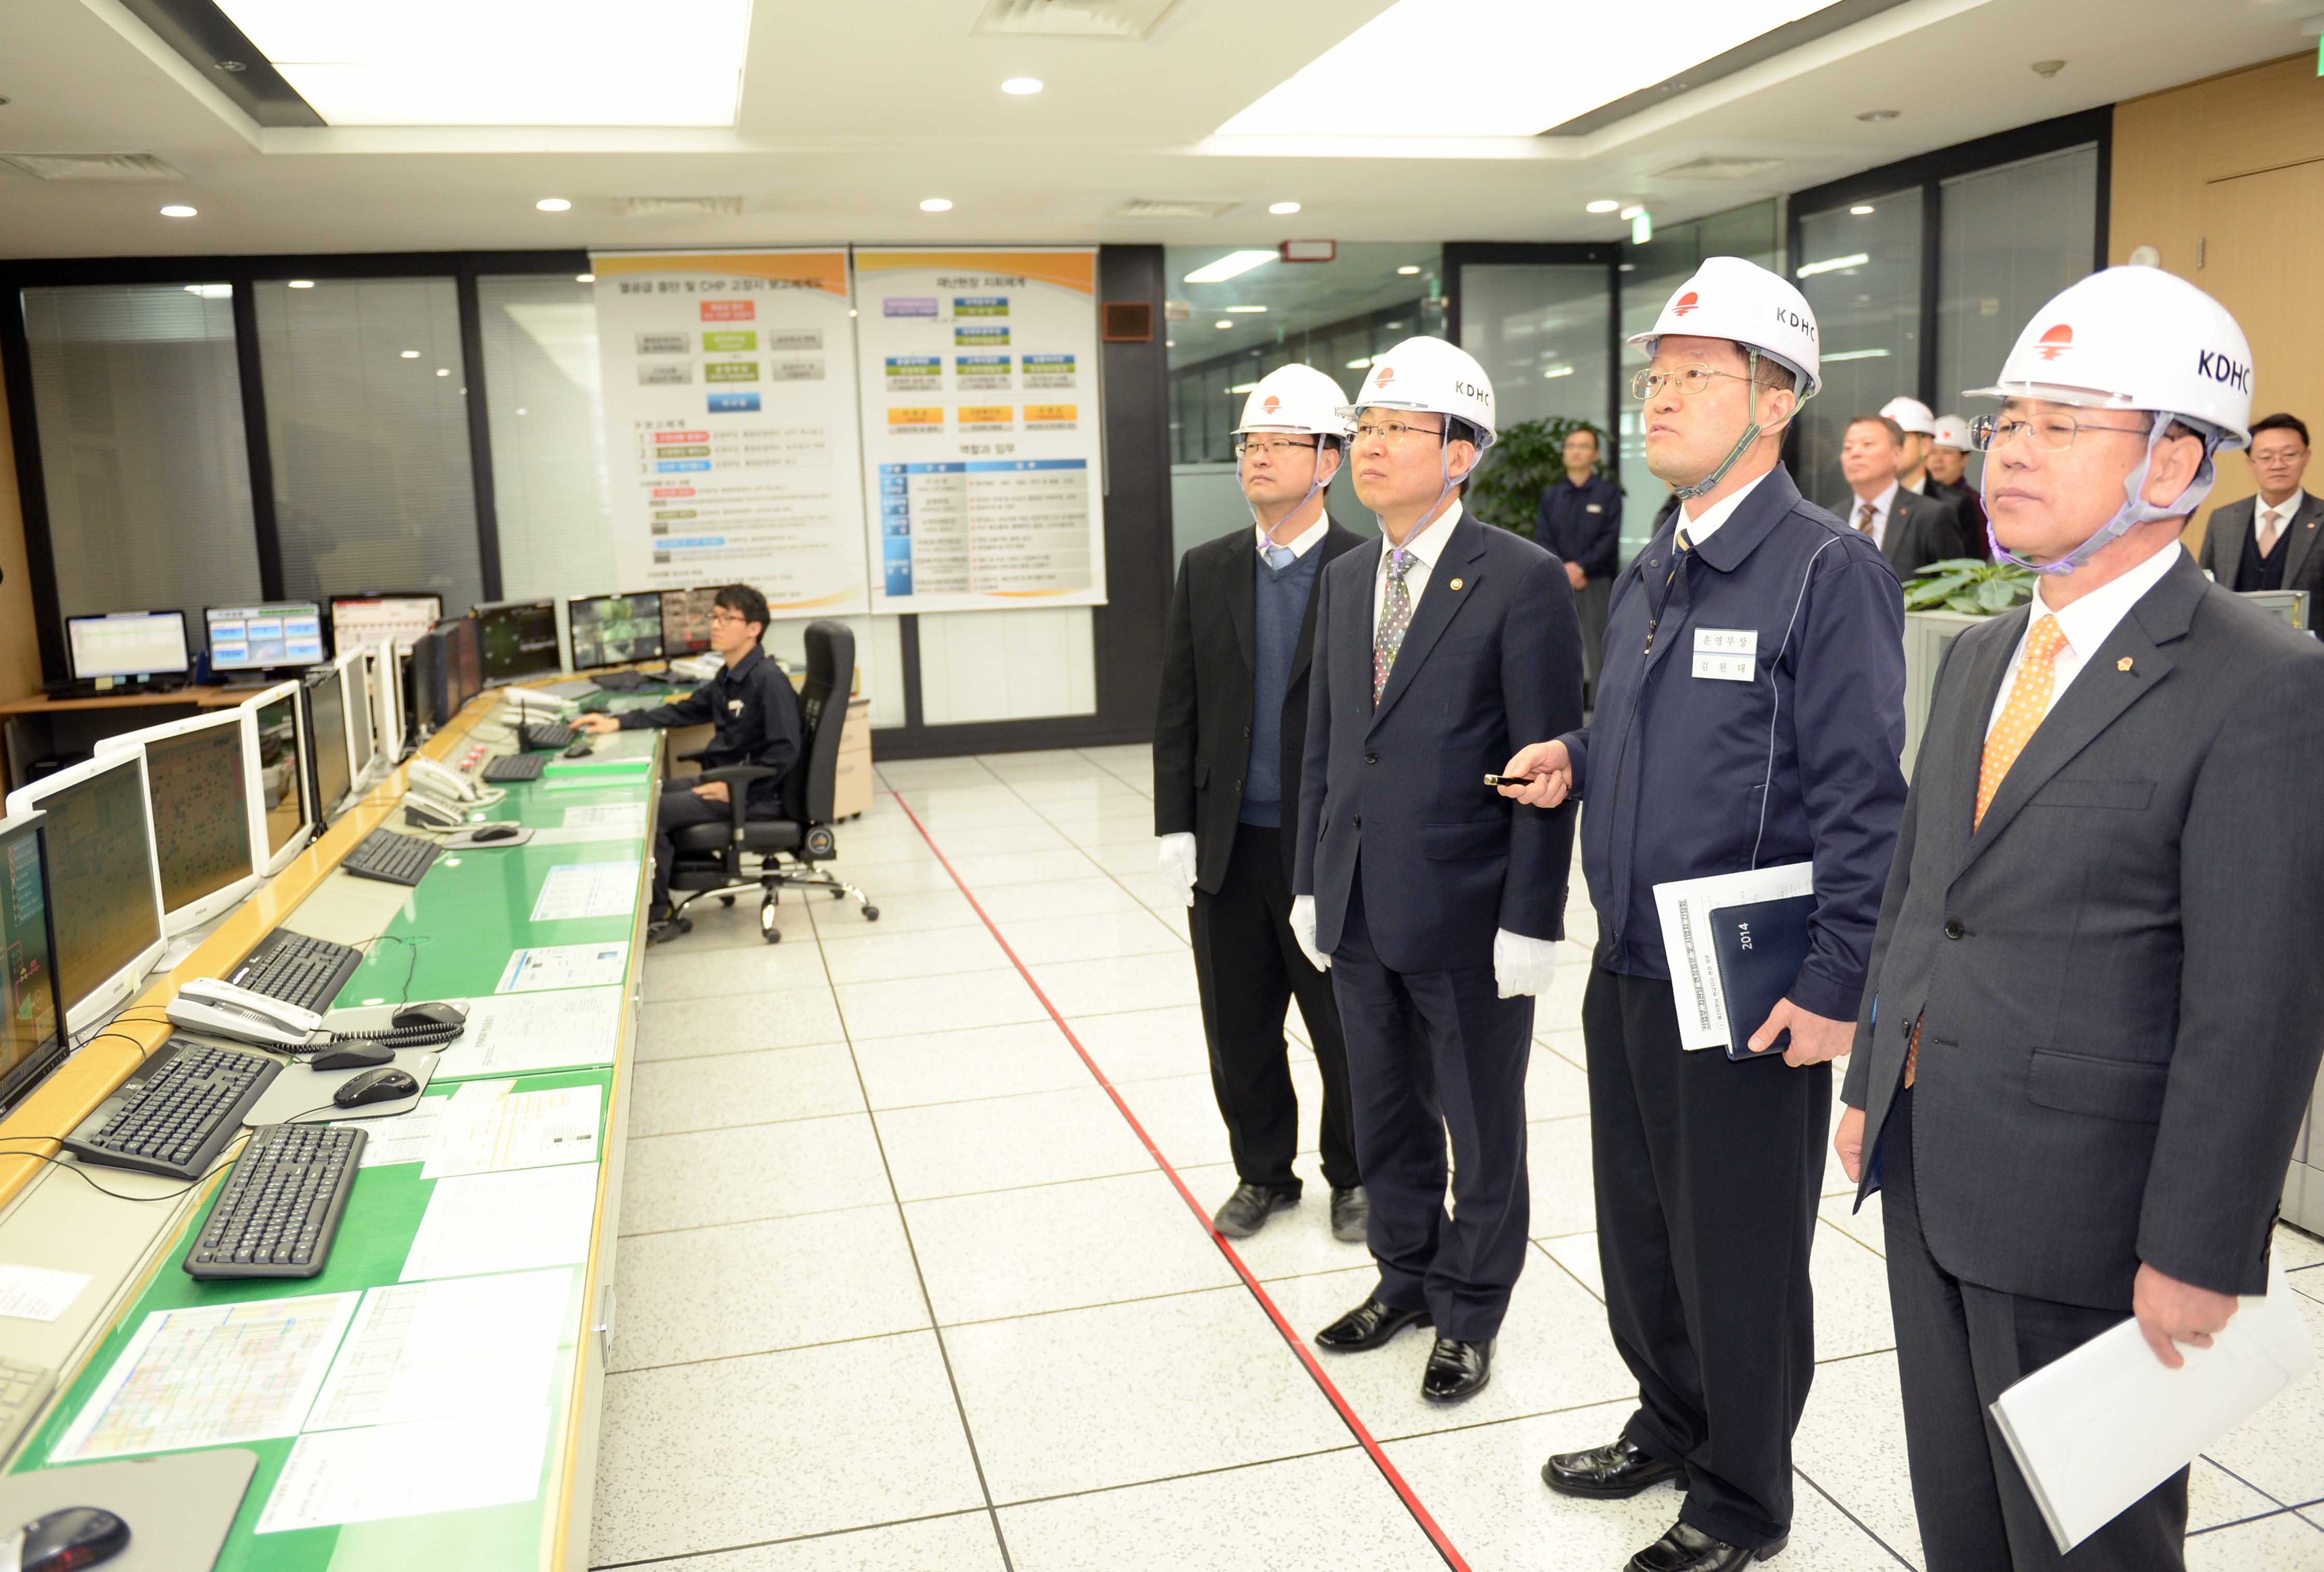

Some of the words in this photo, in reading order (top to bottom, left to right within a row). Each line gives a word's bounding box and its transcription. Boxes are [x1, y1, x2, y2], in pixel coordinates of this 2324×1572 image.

[1777, 307, 1815, 342] KDHC
[2198, 349, 2250, 395] KDHC
[1456, 381, 1489, 407] KDHC
[1703, 636, 1747, 647] 운영부장
[1702, 661, 1746, 673] 김원태
[1738, 922, 1752, 950] 2014
